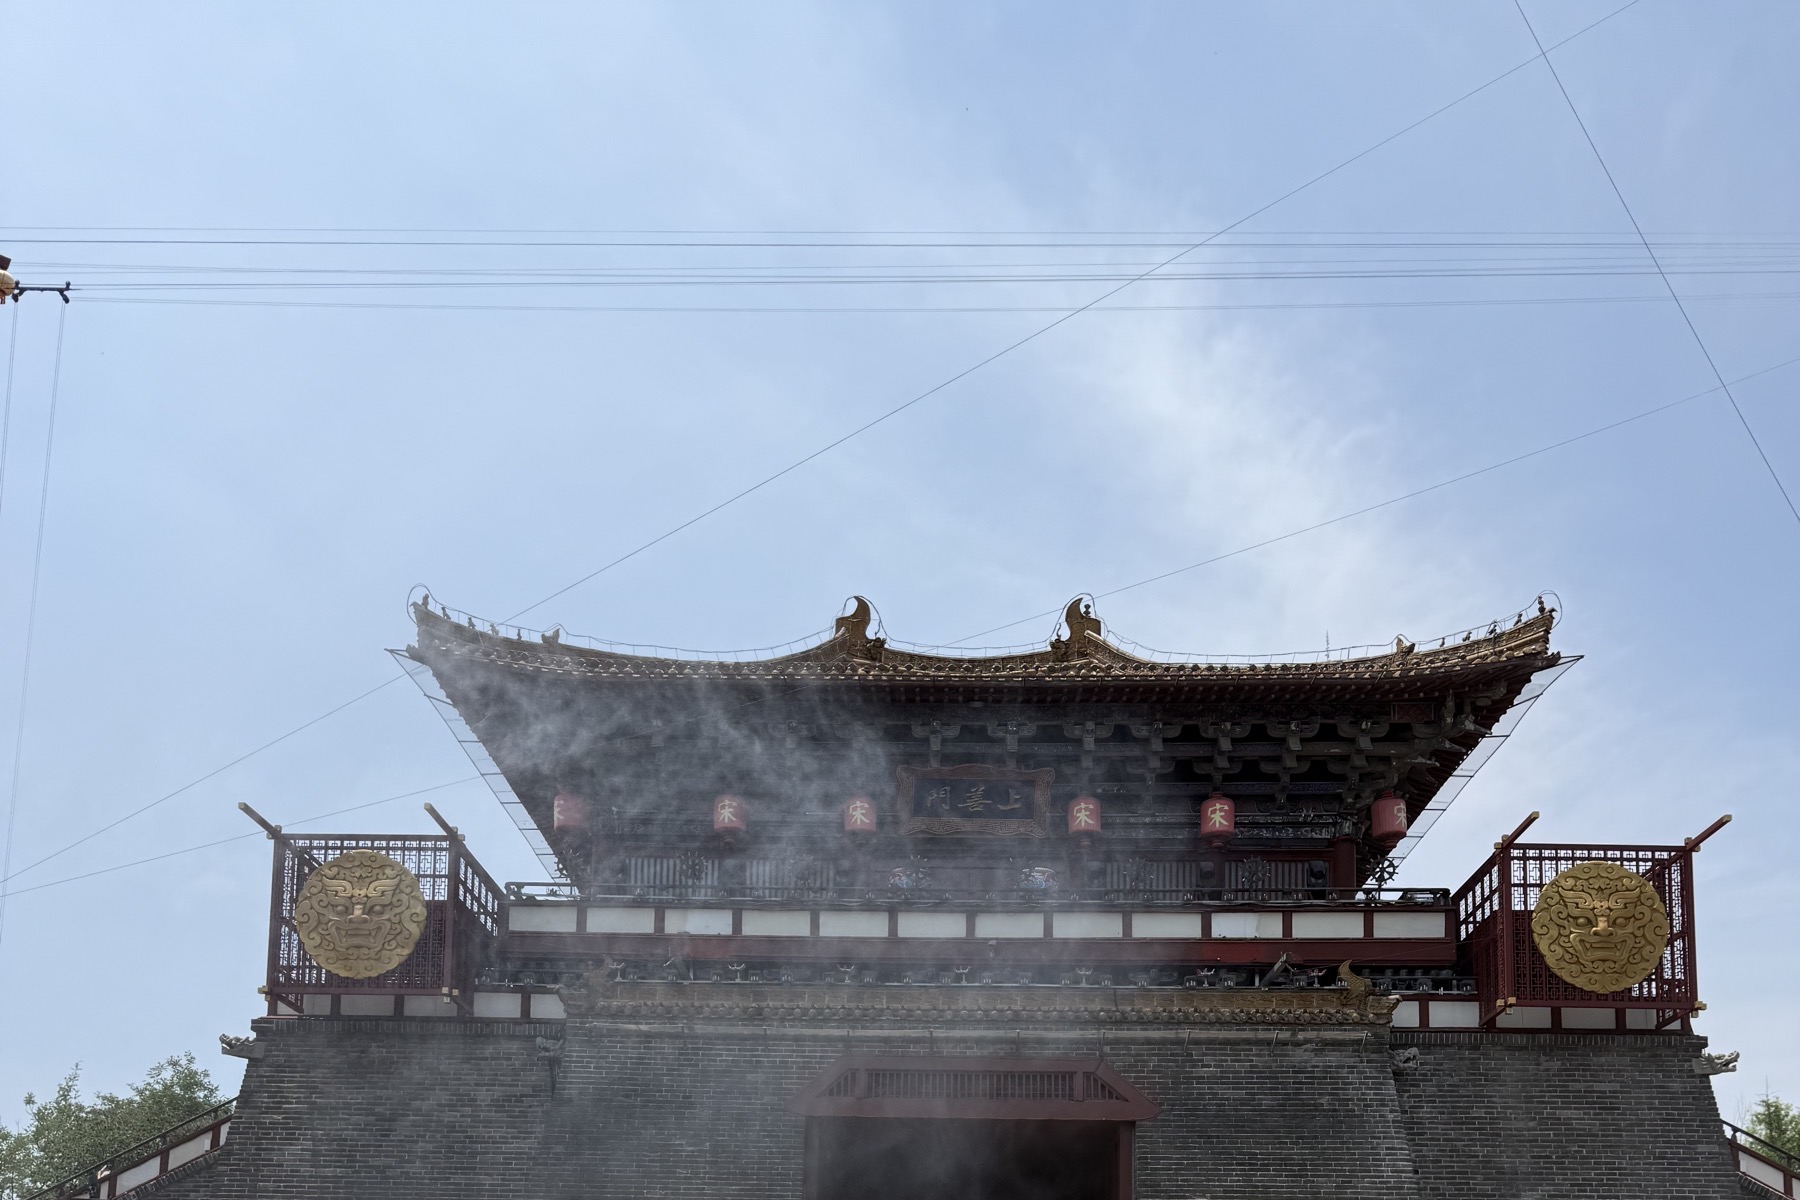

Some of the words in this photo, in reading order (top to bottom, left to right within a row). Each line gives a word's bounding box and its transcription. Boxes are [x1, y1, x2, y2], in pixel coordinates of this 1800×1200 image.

[718, 799, 738, 823] 宋
[850, 800, 870, 825] 宋
[1073, 802, 1095, 827] 宋
[1208, 803, 1229, 829] 宋
